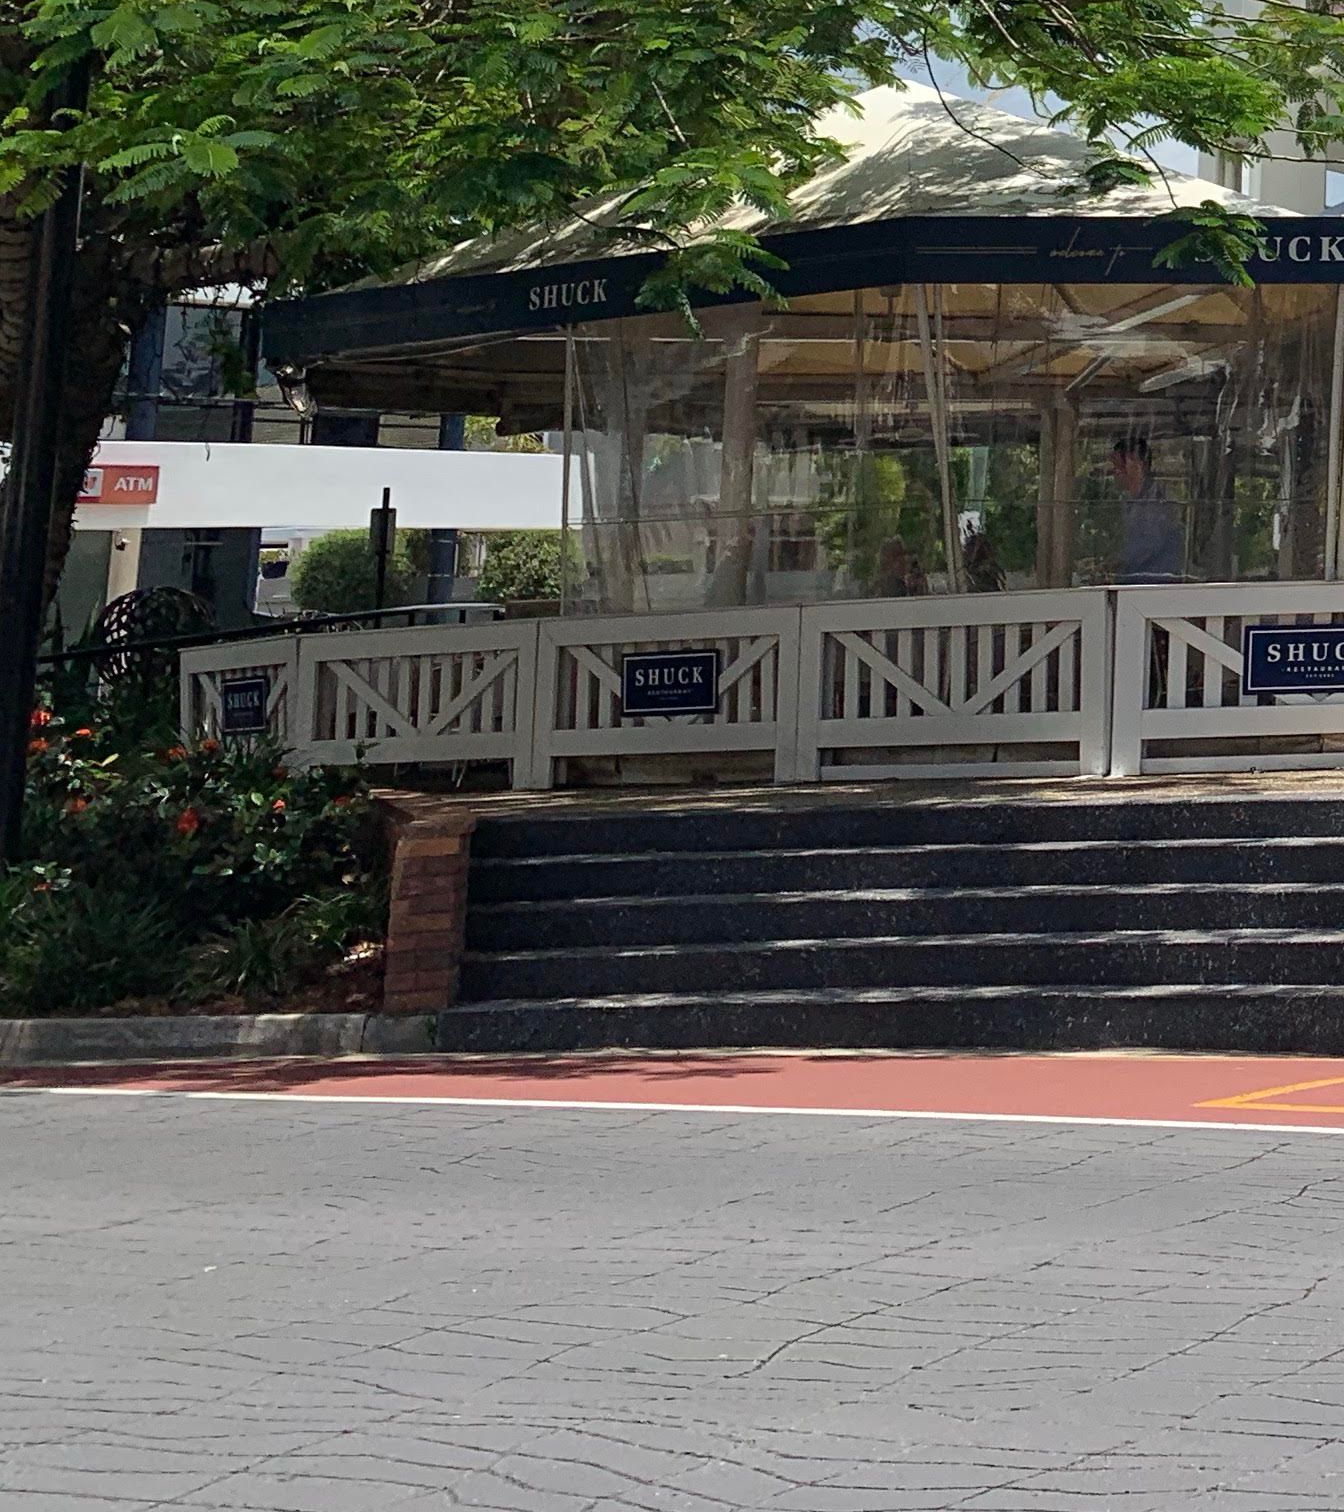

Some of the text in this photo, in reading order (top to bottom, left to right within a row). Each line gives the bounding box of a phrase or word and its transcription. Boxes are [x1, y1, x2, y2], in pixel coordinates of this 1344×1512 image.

[529, 278, 608, 311] SHUCK
[114, 476, 153, 492] ATM
[634, 666, 703, 687] SHUCK
